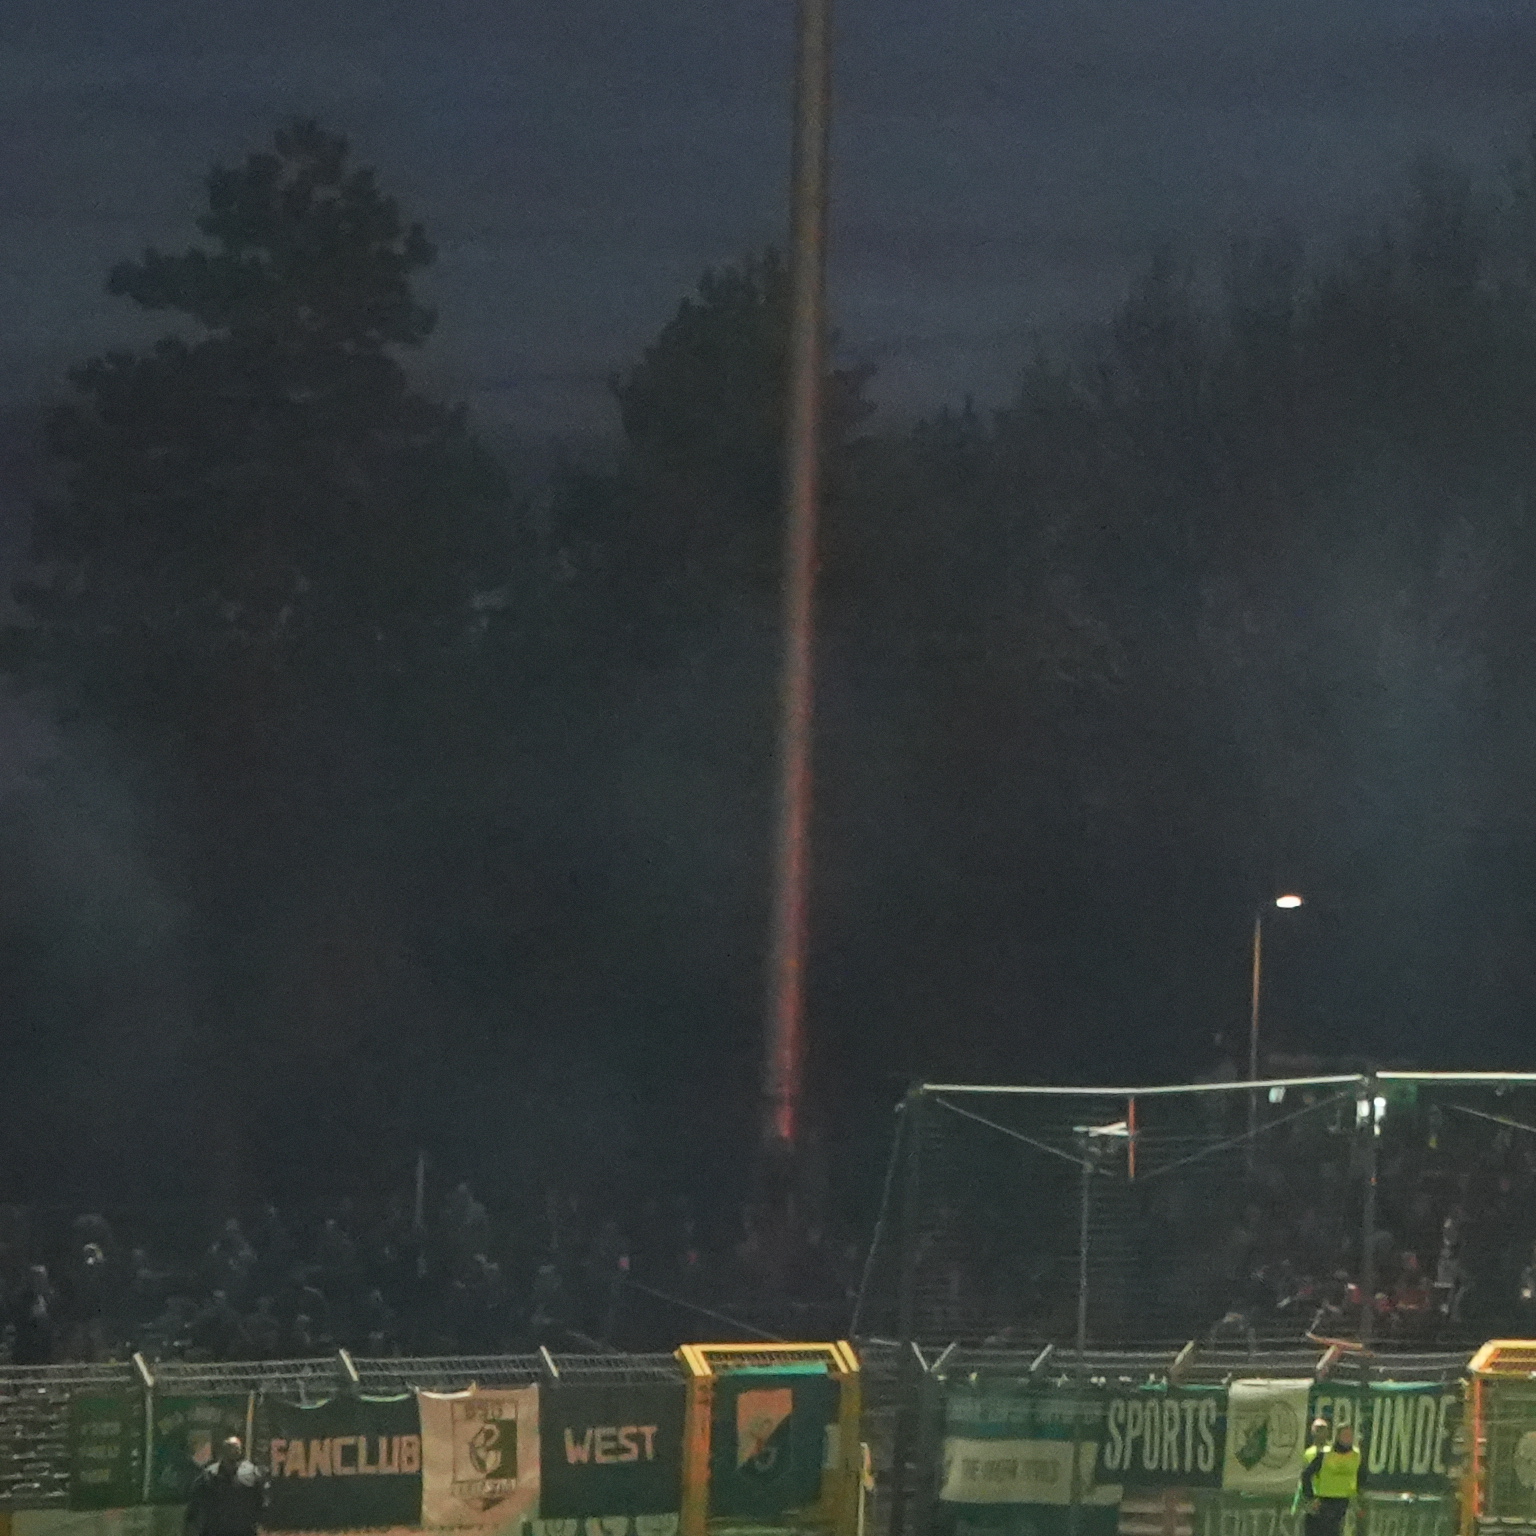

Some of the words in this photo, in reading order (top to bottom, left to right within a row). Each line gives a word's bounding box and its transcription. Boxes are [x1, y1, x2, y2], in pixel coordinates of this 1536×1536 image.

[270, 1434, 422, 1477] FANCLUB
[563, 1424, 659, 1464] WEST
[1103, 1397, 1218, 1473] SPORTS
